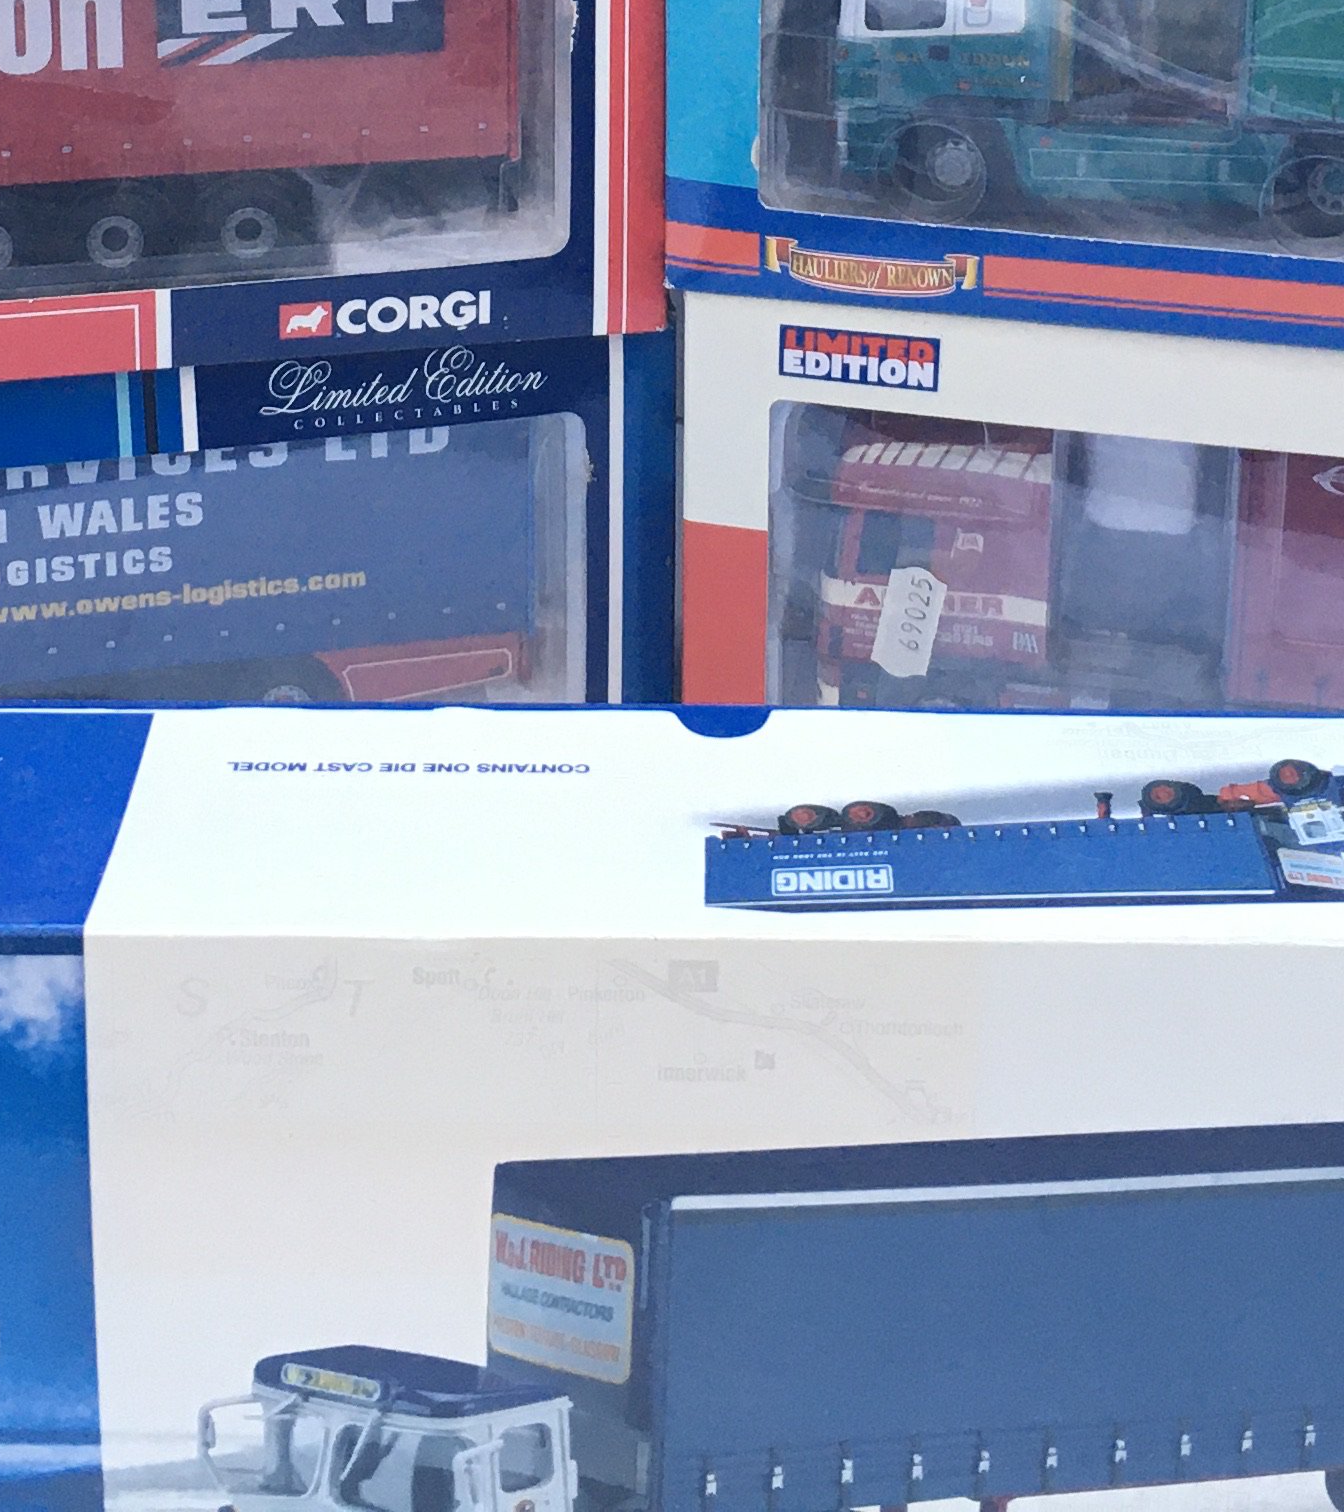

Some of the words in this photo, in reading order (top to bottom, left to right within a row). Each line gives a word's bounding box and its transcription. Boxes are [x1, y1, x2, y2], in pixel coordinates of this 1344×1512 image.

[791, 252, 868, 285] HAULIERS
[886, 264, 954, 289] RENOWN
[336, 290, 492, 336] CORGI
[783, 327, 936, 363] LIMITED
[259, 358, 426, 417] Limited
[425, 344, 549, 406] Edition
[782, 348, 935, 389] EDITION
[293, 397, 520, 431] COLLECTABLES
[38, 491, 205, 540] WALES
[226, 760, 308, 774] MODEL
[313, 760, 374, 774] CAST
[379, 761, 417, 774] DIE
[422, 761, 471, 774] ONE
[476, 761, 591, 774] CONTAINS
[776, 868, 889, 893] RIDING
